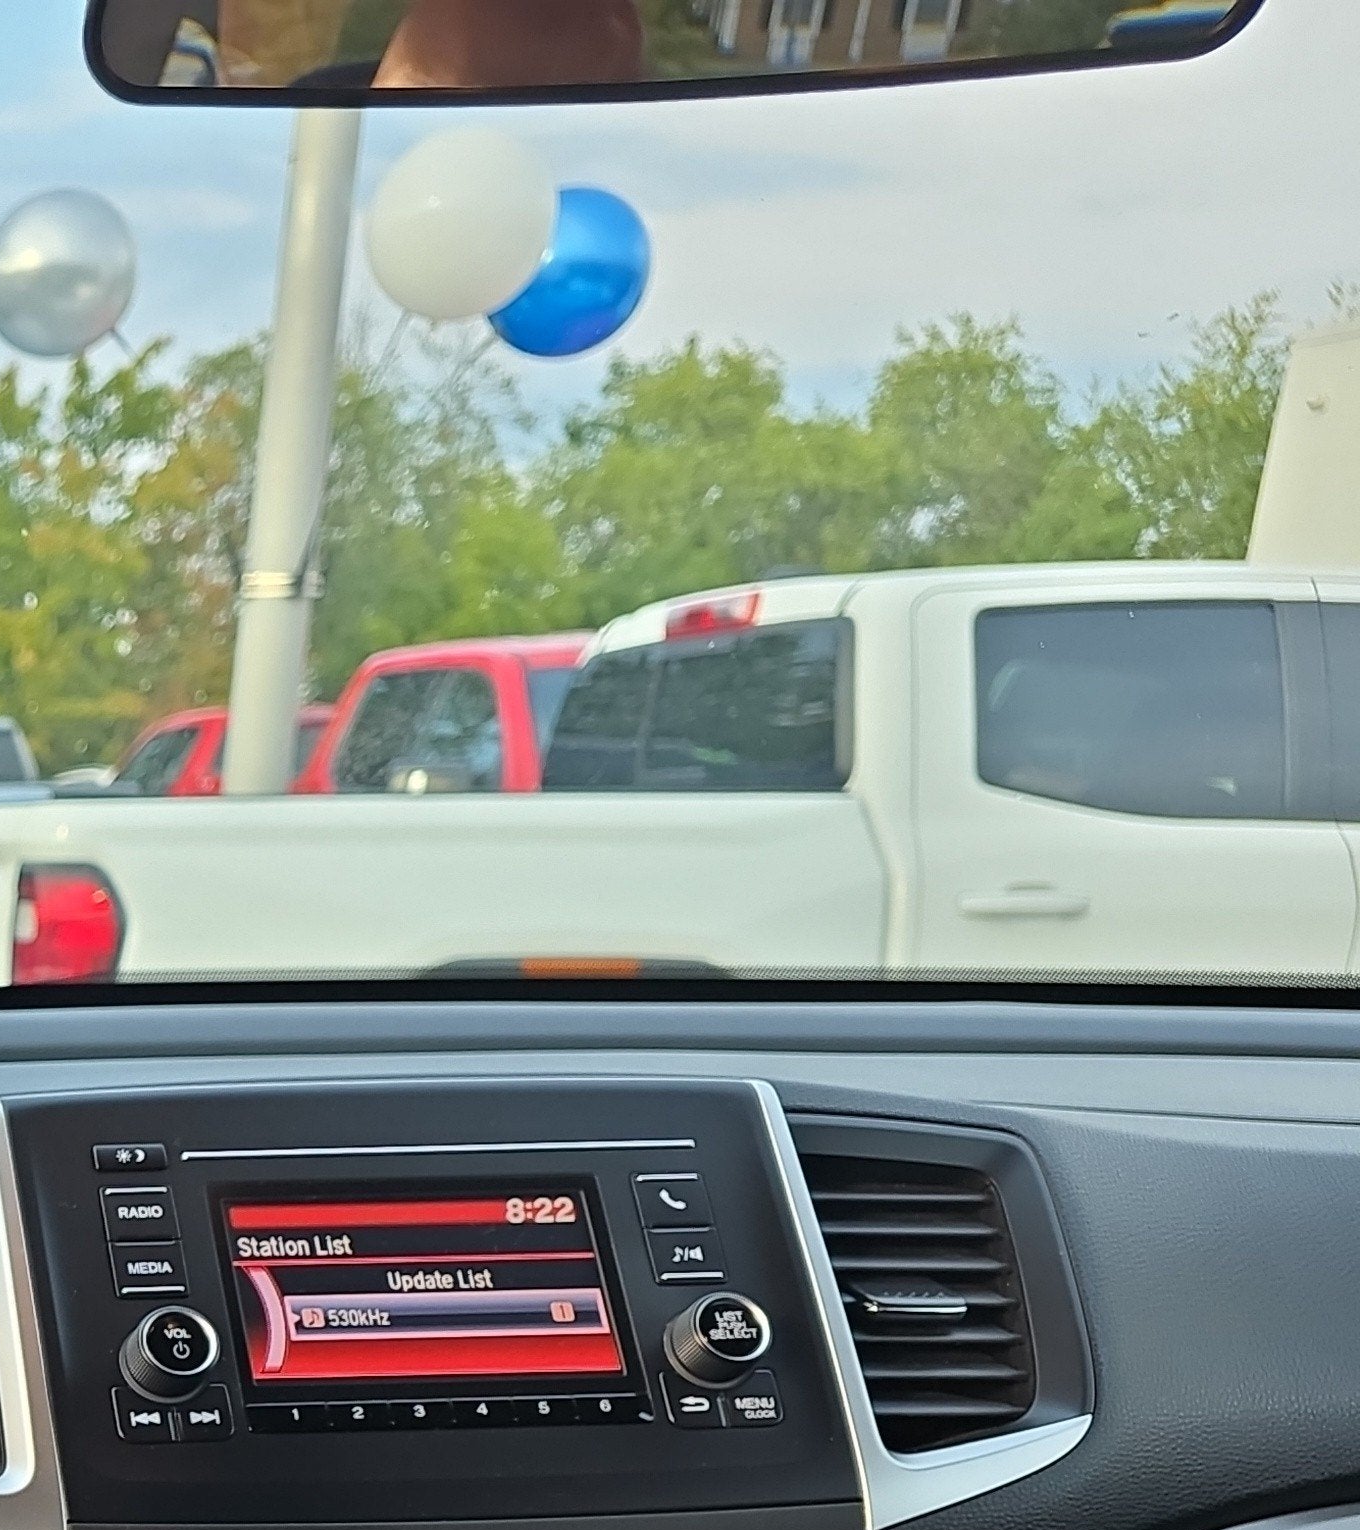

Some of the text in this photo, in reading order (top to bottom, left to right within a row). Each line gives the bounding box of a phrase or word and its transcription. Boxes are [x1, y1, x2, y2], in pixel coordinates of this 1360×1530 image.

[118, 1205, 163, 1219] RADIO
[505, 1197, 576, 1224] 8:22
[237, 1234, 353, 1257] Station List
[127, 1261, 173, 1275] MEDIA
[387, 1269, 494, 1292] Update List
[327, 1309, 391, 1327] 530kHz
[714, 1310, 744, 1322] LIST
[163, 1328, 191, 1339] VOL
[709, 1327, 758, 1340] SELECT
[291, 1400, 612, 1421] 1 2 3 4 5 6
[734, 1397, 775, 1410] MENU
[744, 1408, 777, 1419] CLOCK
